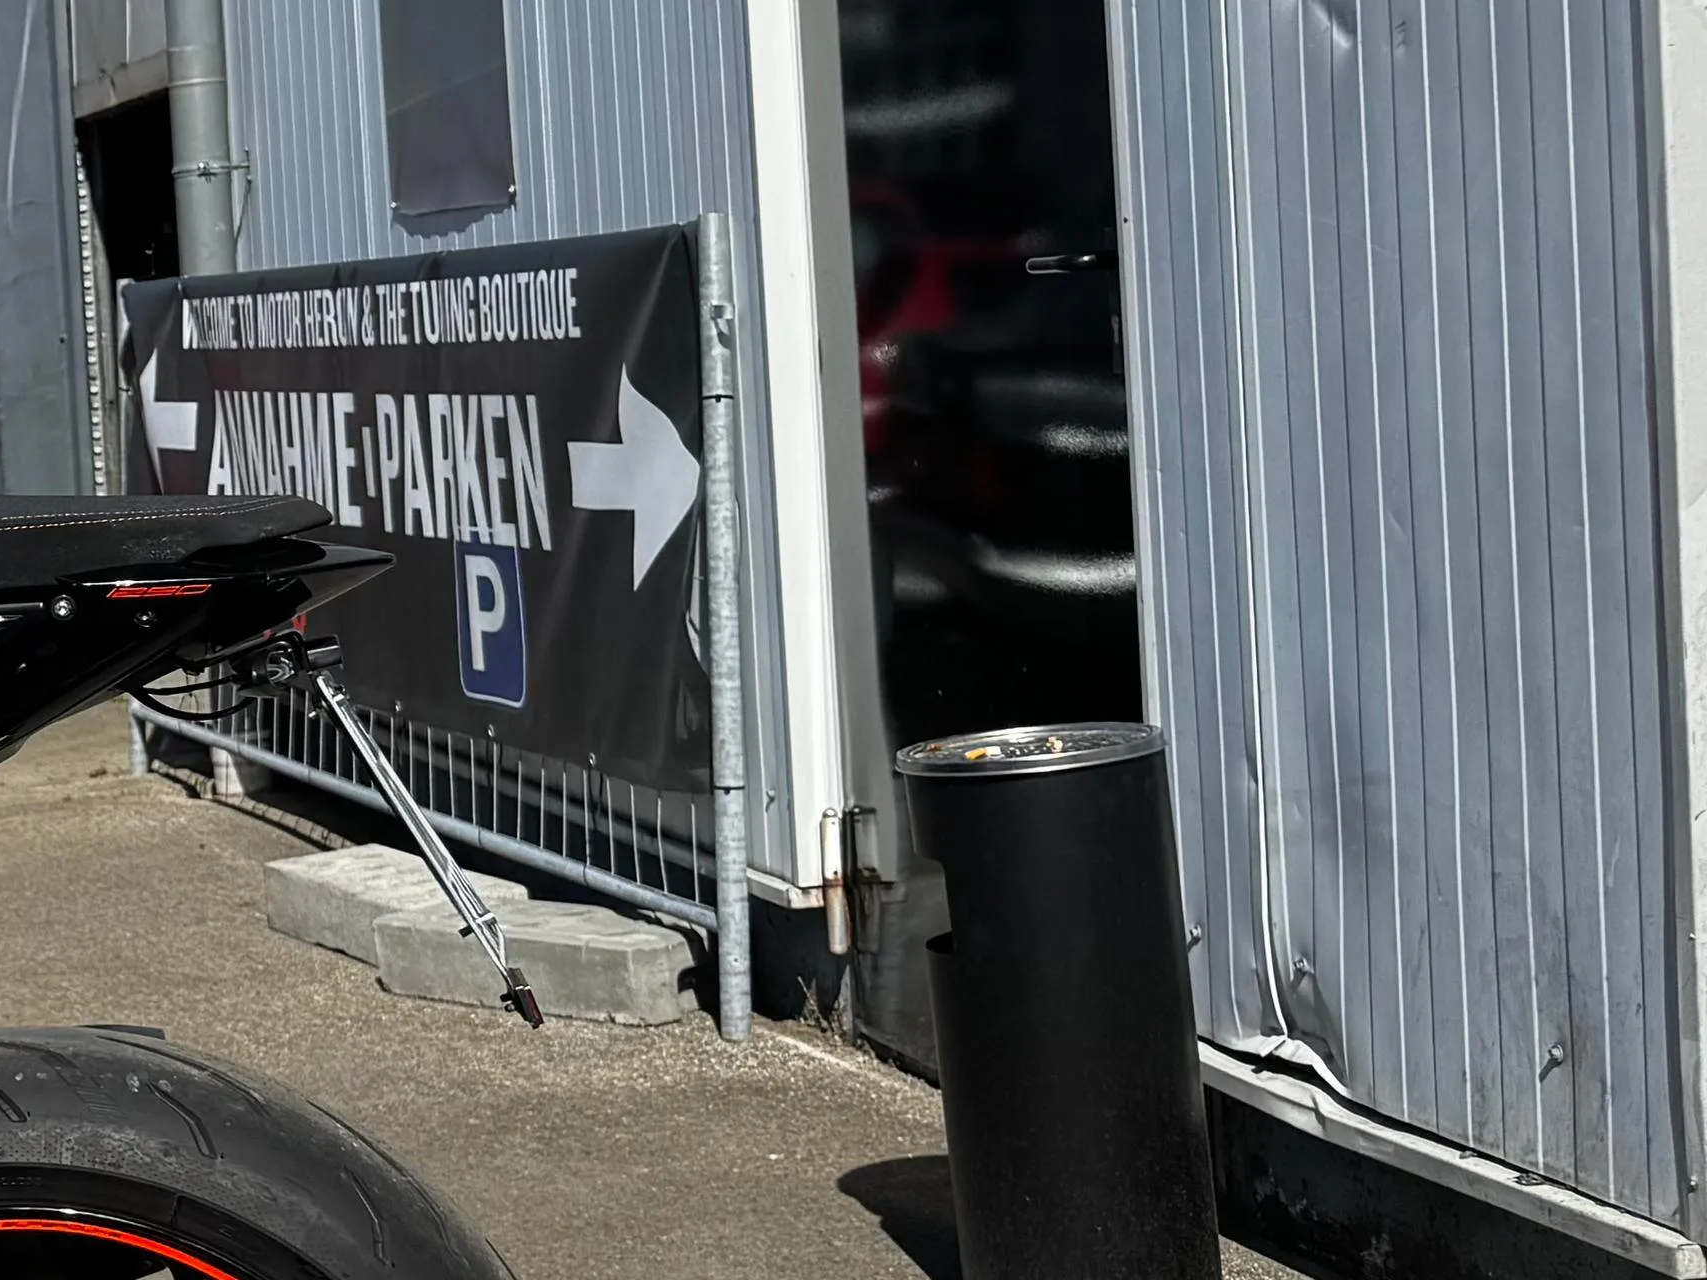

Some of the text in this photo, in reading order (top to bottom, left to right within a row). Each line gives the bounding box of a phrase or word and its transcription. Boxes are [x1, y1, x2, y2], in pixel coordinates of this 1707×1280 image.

[237, 294, 255, 350] TO
[256, 291, 303, 350] MOTOR
[361, 284, 375, 347] &
[375, 282, 408, 346] THE
[478, 268, 582, 342] BOUTIQUE
[207, 390, 553, 552] ANNAHME PARKEN
[464, 554, 505, 673] P
